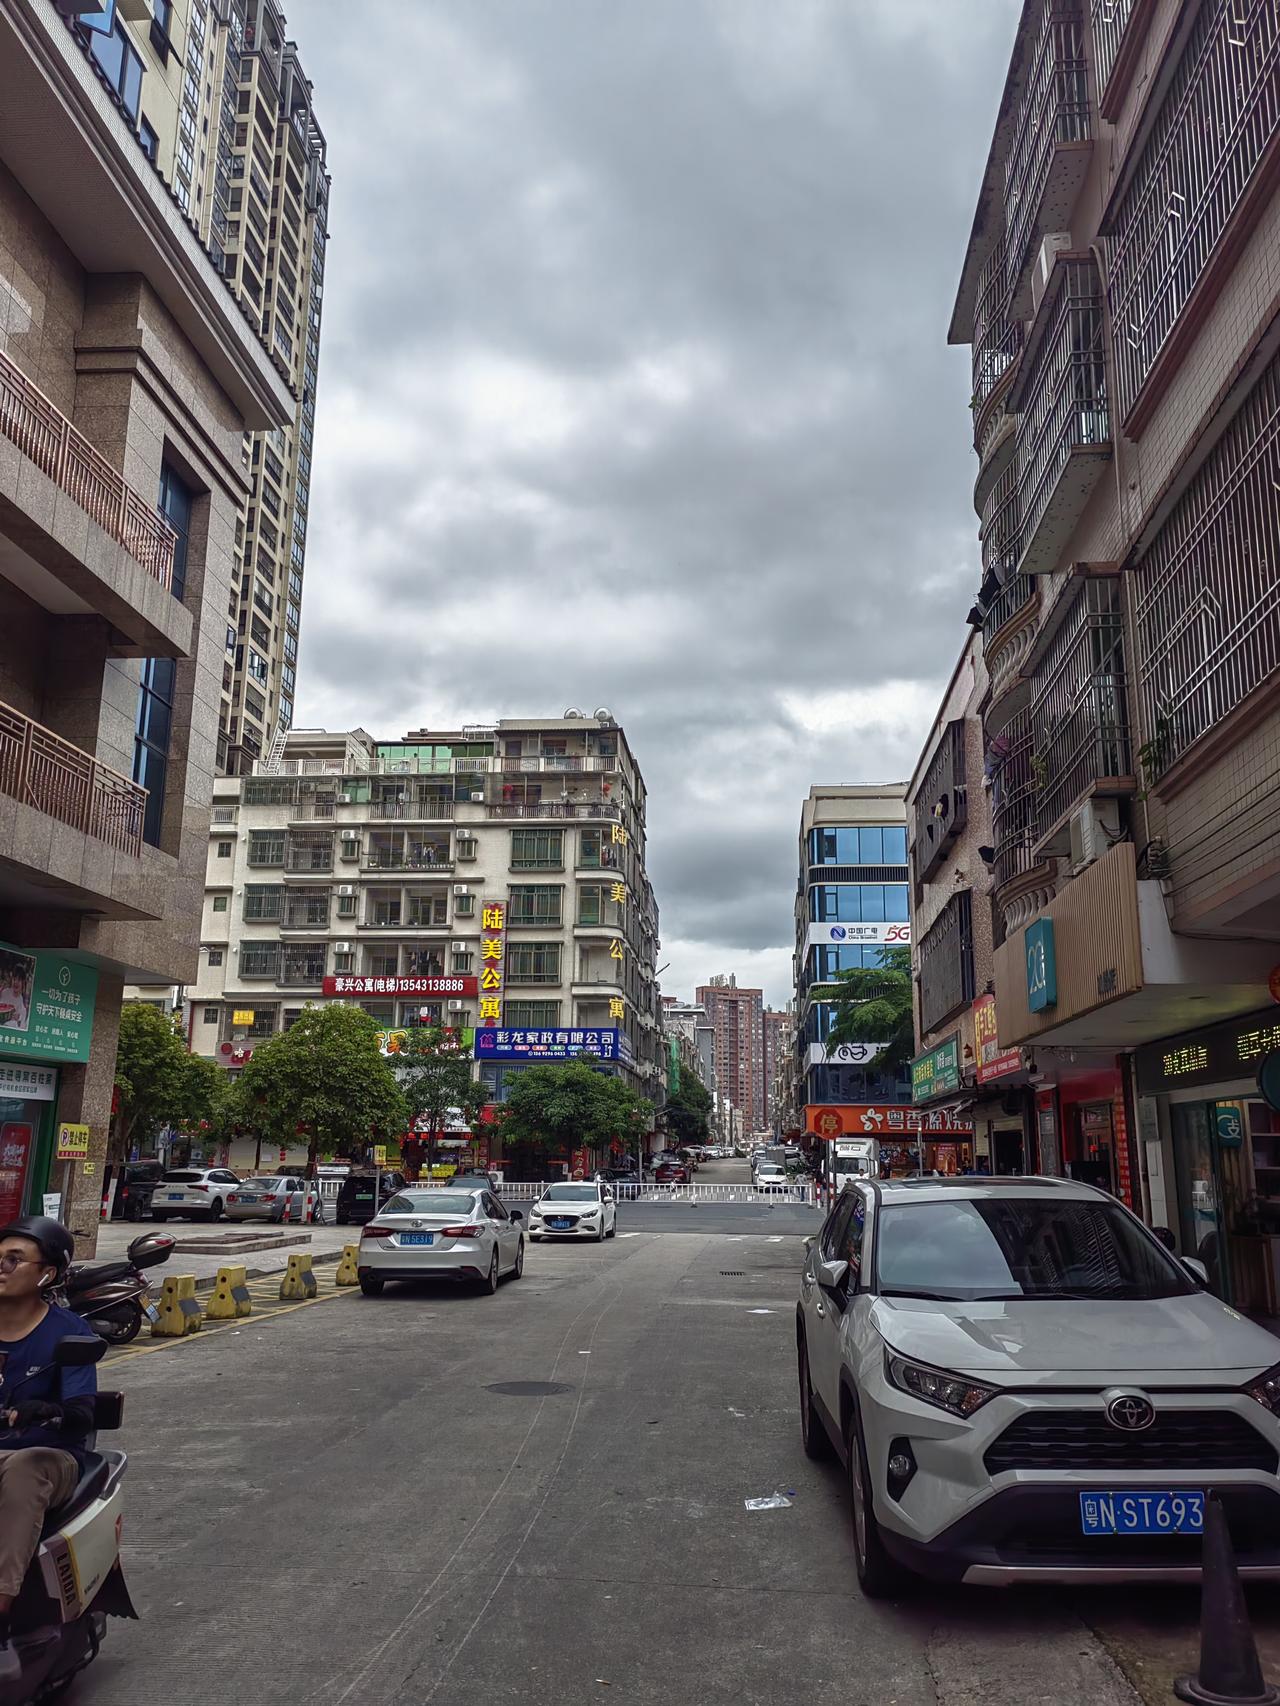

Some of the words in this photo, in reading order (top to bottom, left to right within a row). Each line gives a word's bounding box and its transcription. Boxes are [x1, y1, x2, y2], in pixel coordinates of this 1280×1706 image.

[609, 824, 627, 1019] 陆美公寓
[848, 927, 878, 935] 中国广电
[884, 925, 911, 942] 5G
[480, 909, 503, 1019] 陆美公寓
[496, 1031, 614, 1045] 彩龙家政有限公司
[820, 1114, 839, 1134] 停
